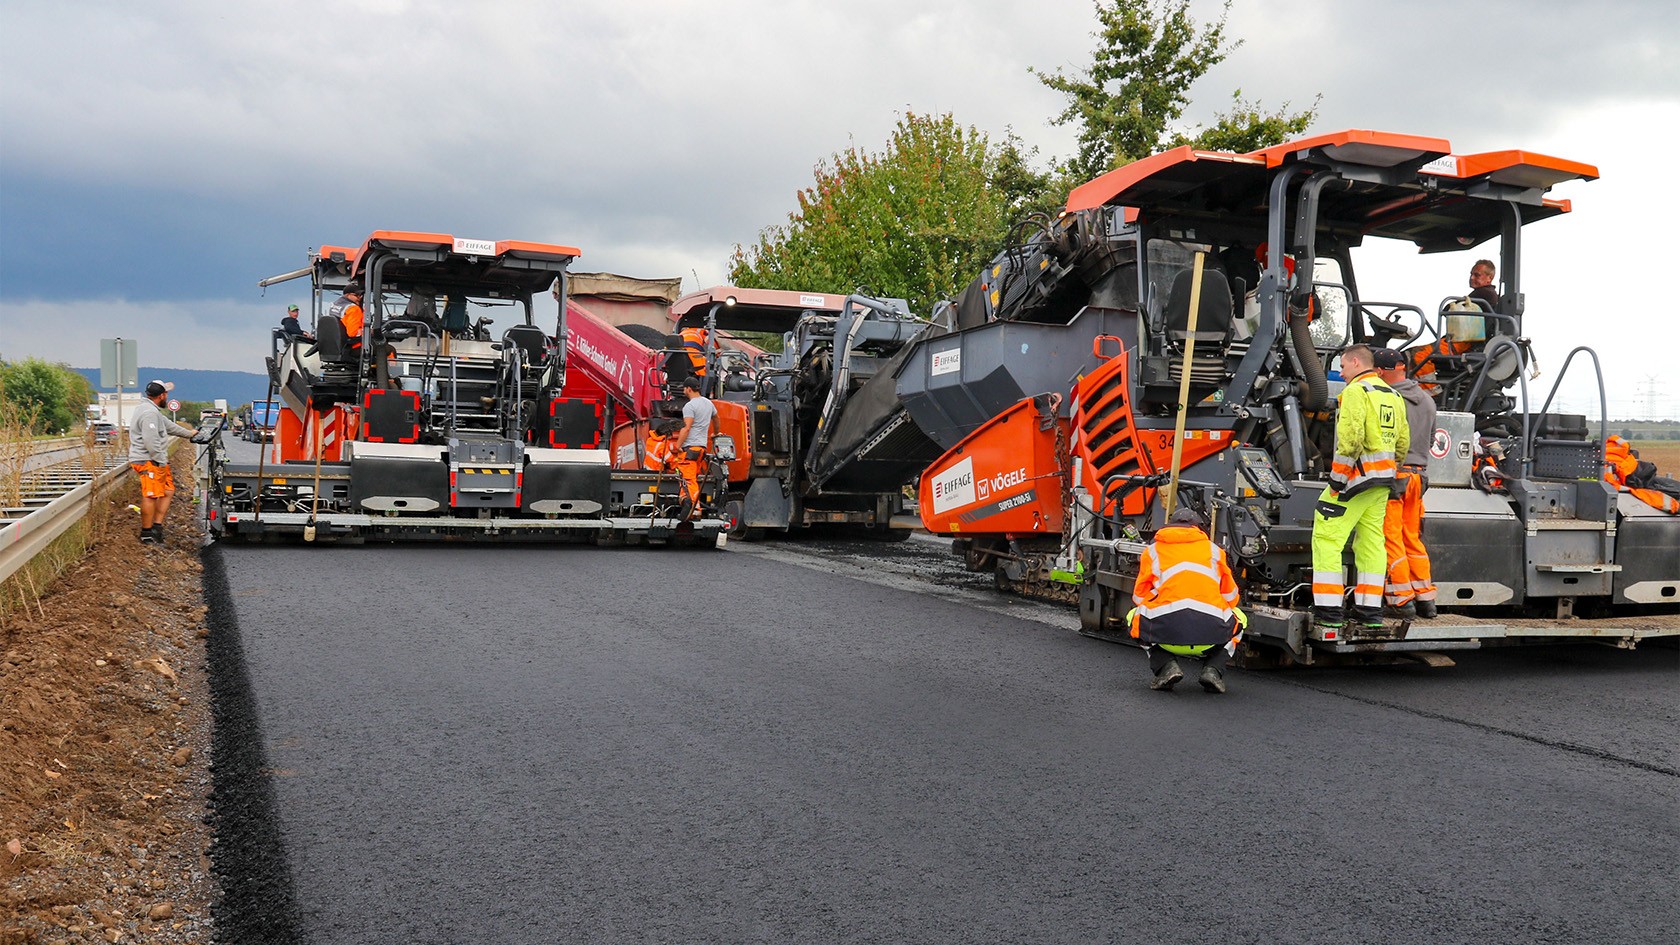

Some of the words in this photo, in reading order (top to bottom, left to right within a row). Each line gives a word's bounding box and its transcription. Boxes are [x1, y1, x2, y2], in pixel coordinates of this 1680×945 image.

[465, 242, 492, 251] EIFFAGE
[940, 354, 959, 366] EIFFAGE
[944, 472, 971, 494] EIFFAGE
[990, 467, 1027, 492] VÖGELE
[998, 499, 1014, 511] SUPER
